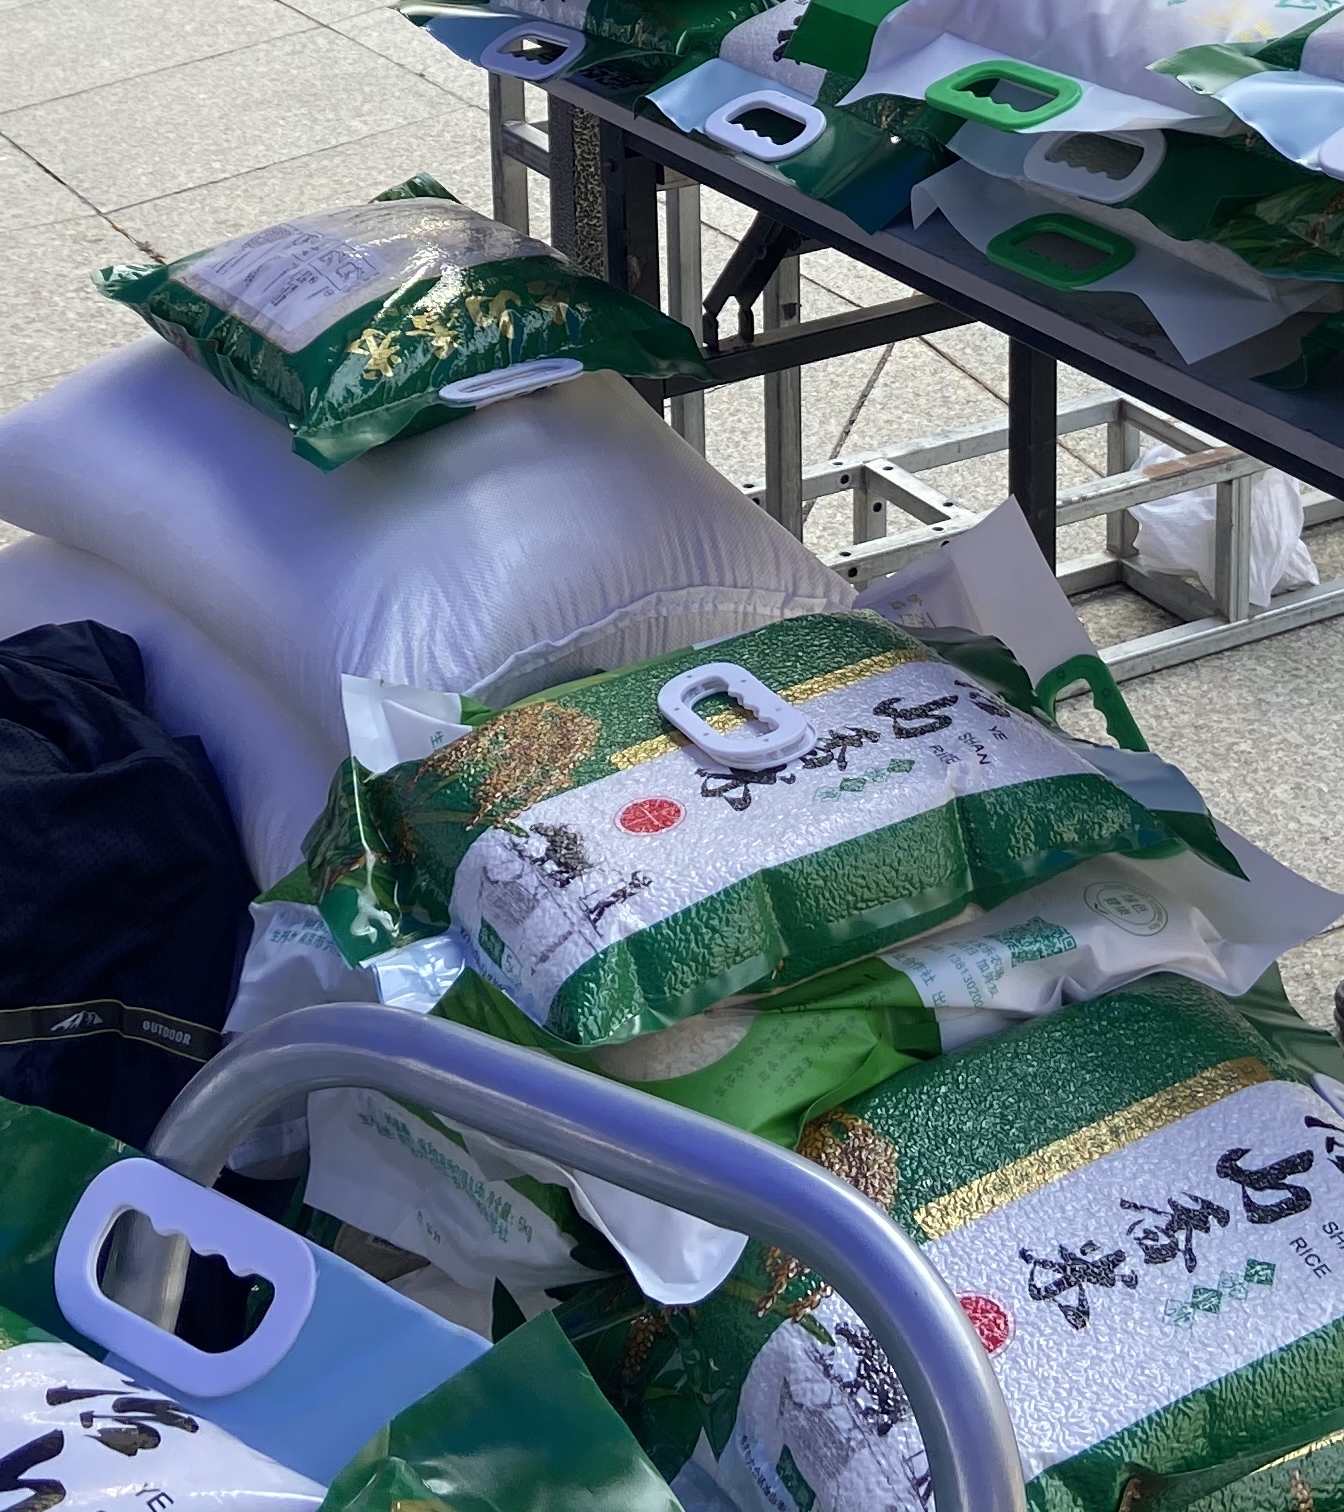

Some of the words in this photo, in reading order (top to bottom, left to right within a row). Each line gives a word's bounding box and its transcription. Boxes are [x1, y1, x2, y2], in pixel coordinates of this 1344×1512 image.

[988, 724, 1010, 741] YE
[928, 743, 962, 766] RICE
[957, 731, 991, 766] SHAN
[142, 1019, 193, 1046] OUTDOOR
[1288, 1235, 1333, 1280] RICE
